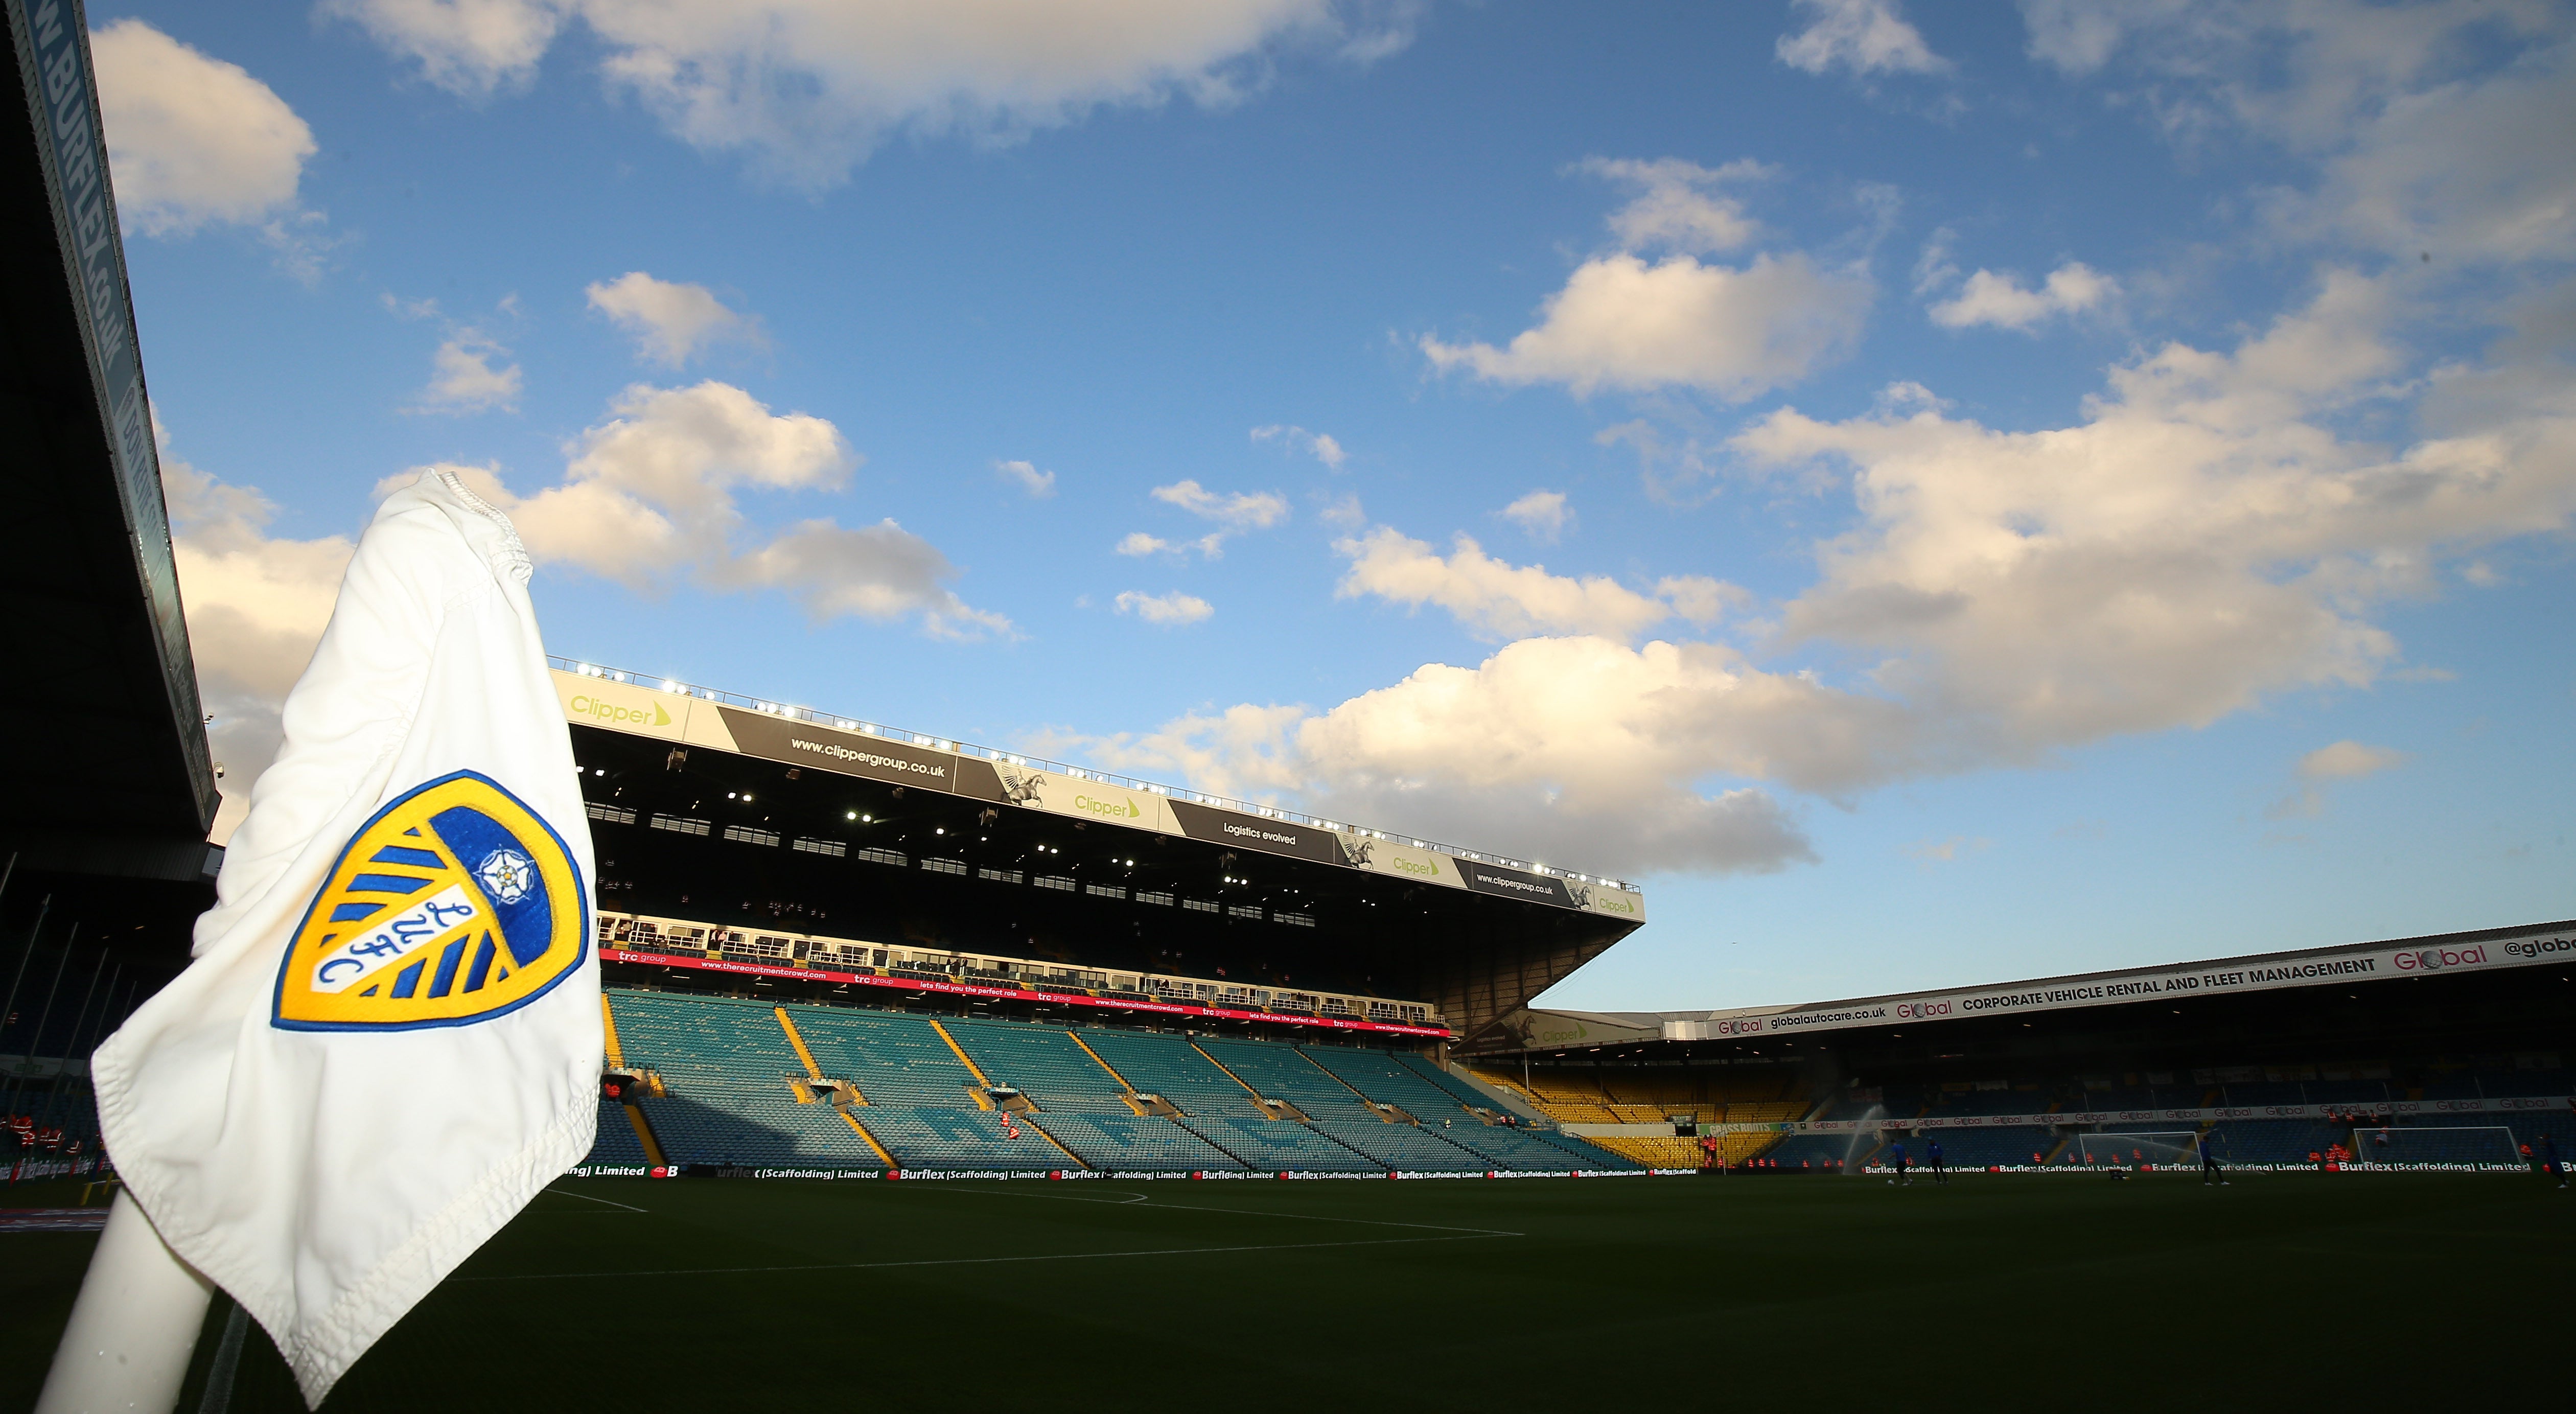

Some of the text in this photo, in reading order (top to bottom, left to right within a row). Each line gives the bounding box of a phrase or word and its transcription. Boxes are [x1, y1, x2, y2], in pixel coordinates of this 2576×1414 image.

[123, 408, 144, 471] DON
[133, 454, 152, 518] REVIE
[570, 695, 652, 725] Clipper
[791, 738, 946, 778] www.clippergroup.co.uk
[1075, 795, 1127, 818] Clipper
[1224, 822, 1296, 846] Logistics evolved
[1393, 857, 1430, 875] Clipper
[1477, 874, 1553, 895] www.clippergroup.co.uk
[1599, 897, 1628, 913] Clipper
[319, 901, 473, 984] LUFC
[619, 951, 666, 964] trc group
[2394, 945, 2488, 970] Global
[701, 961, 827, 979] www.therecruitmentcrowd.com
[854, 974, 894, 986] trc group
[1963, 958, 2376, 1011] CORPORATE VEHICLE RENTAL AND FLEET MANAGEMENT
[1038, 992, 1072, 1002] trc group
[1095, 999, 1183, 1012] www.therecruitmentcrowd.com
[1202, 1007, 1214, 1015] trc
[1897, 1000, 1952, 1018] Global
[1771, 1007, 1886, 1029] globalautocare.co.uk
[1375, 1025, 1440, 1035] www.therecruitmentcrowd.com
[1719, 1018, 1762, 1034] Global
[1543, 1028, 1579, 1043] Clipper
[2376, 1102, 2420, 1113] Global
[2436, 1100, 2482, 1110] Global
[2499, 1098, 2549, 1109] Global
[2119, 1111, 2154, 1121] Global
[2166, 1109, 2201, 1119] Global
[2215, 1107, 2252, 1118] Global
[2265, 1106, 2305, 1116] Global
[1992, 1116, 2022, 1124] Global
[2033, 1114, 2064, 1124] Global
[2075, 1112, 2107, 1122] Global
[1709, 1123, 1771, 1137] GRASS ROOTS
[595, 1166, 645, 1175] Limited
[1865, 1166, 1897, 1174] Burflex
[2152, 1163, 2196, 1171] Burflex
[2276, 1163, 2319, 1171] Limited
[2338, 1162, 2531, 1172] Burflex (Scaffolding) Limited
[761, 1169, 834, 1179] (Scaffolding)
[838, 1169, 878, 1179] Limited
[900, 1169, 1046, 1180] Burflex (Scaffolding) Limited
[1061, 1170, 1100, 1179] Burflex
[1101, 1171, 1154, 1180] (affolding)
[1288, 1171, 1318, 1180] Burflex
[1319, 1172, 1361, 1180] (Scaffolding)
[1397, 1171, 1424, 1179] Burflex
[1494, 1170, 1518, 1178] Burflex
[1578, 1169, 1599, 1177] Burflex
